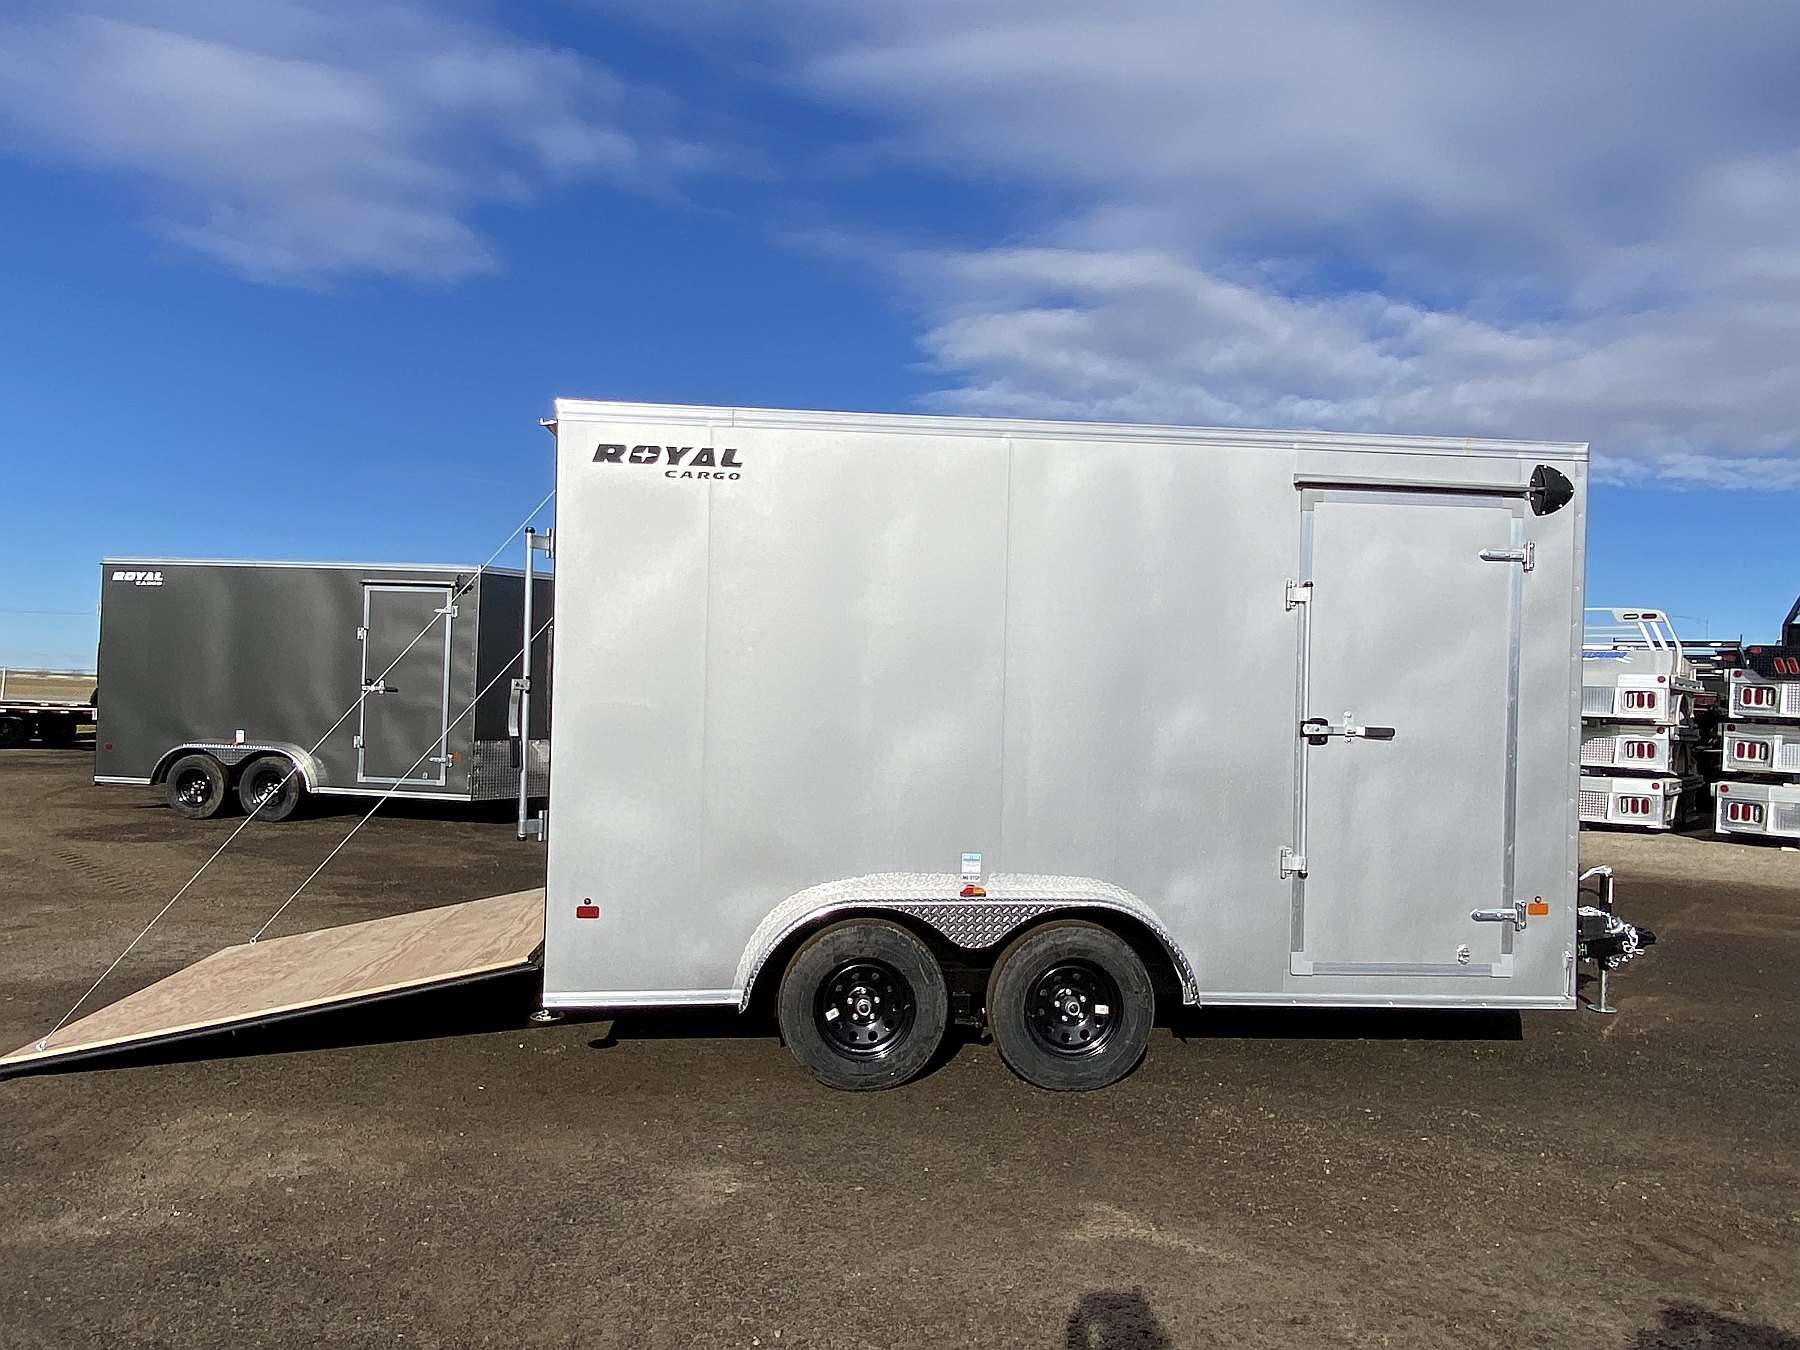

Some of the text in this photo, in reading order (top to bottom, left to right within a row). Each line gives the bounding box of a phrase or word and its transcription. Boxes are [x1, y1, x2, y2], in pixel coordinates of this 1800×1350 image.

[592, 443, 743, 468] ROYAL
[664, 470, 741, 480] CARGO
[112, 571, 163, 581] ROYAL
